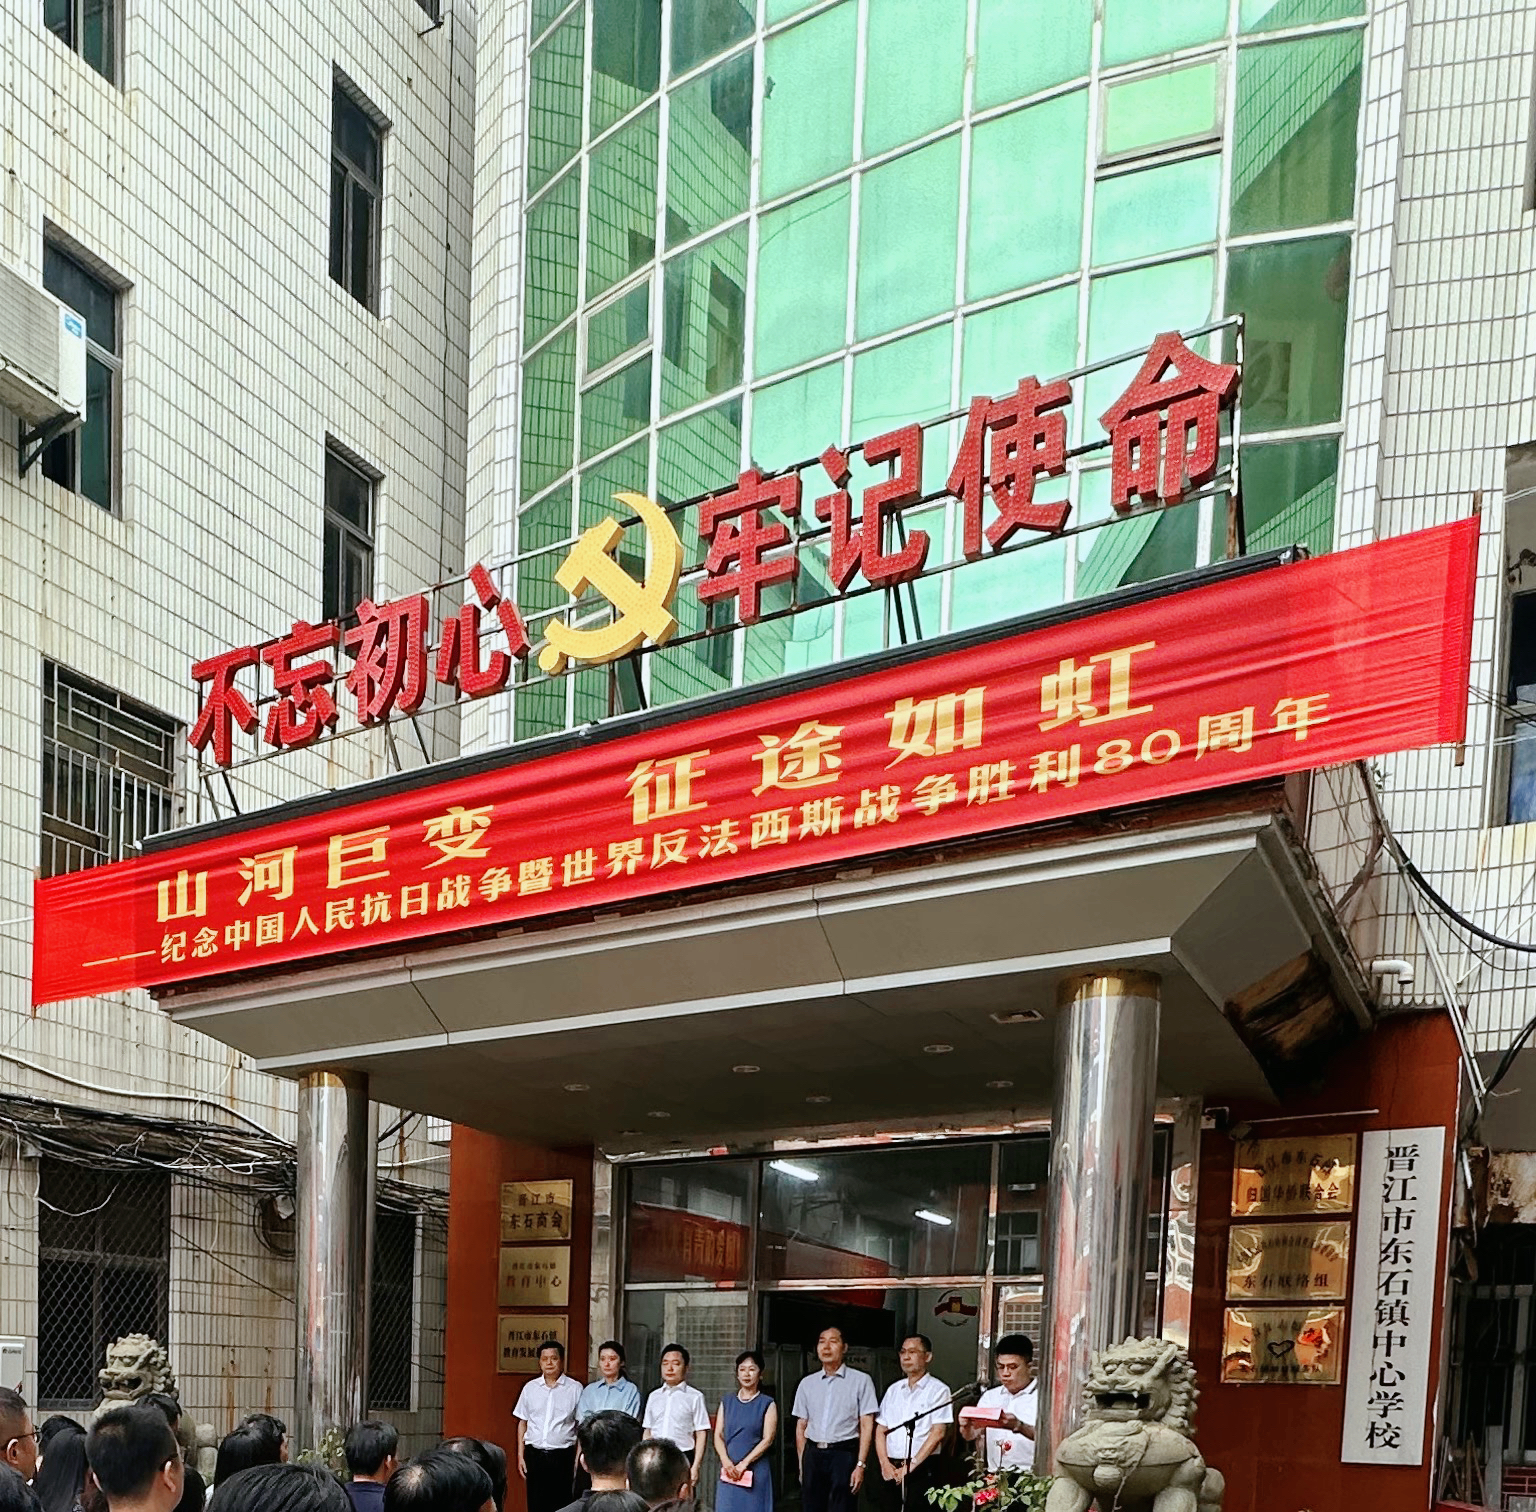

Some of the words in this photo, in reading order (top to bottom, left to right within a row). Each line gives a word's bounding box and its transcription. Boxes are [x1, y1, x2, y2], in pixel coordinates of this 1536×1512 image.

[187, 560, 529, 768] 不忘初心
[694, 330, 1239, 625] 牢记使命
[156, 805, 494, 924] 山河巨变
[624, 640, 1157, 826] 征途如虹
[510, 1211, 563, 1230] 东石商会
[1365, 1144, 1420, 1449] 晋江市东石镇中心学校
